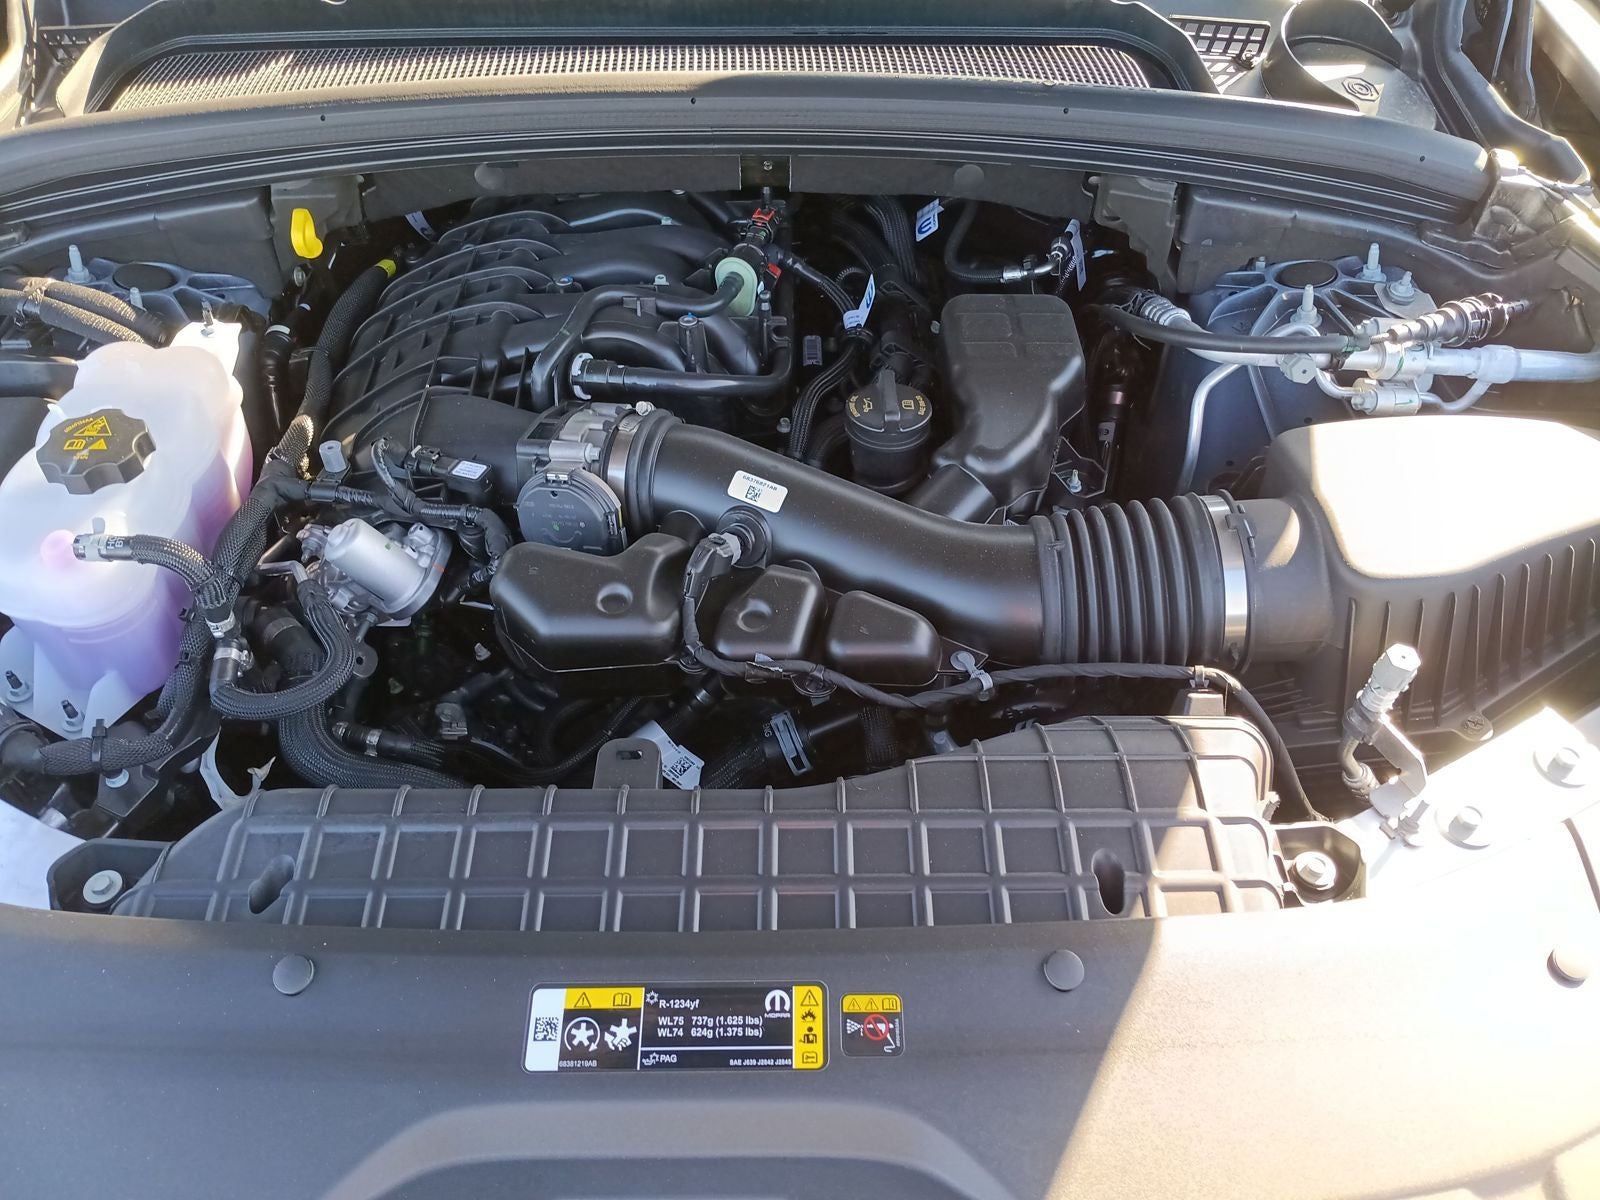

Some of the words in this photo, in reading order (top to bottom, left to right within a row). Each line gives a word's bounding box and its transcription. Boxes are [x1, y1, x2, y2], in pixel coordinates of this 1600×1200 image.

[659, 998, 700, 1010] R-1234yf
[658, 1016, 684, 1026] WL75
[691, 1016, 714, 1028] 737g
[715, 1015, 743, 1027] (1.625
[745, 1015, 763, 1027] lbs)
[657, 1027, 683, 1037] WL74
[690, 1027, 713, 1039] 624g
[715, 1027, 743, 1038] (1.375
[745, 1027, 763, 1038] lbs)
[660, 1054, 678, 1063] PAG
